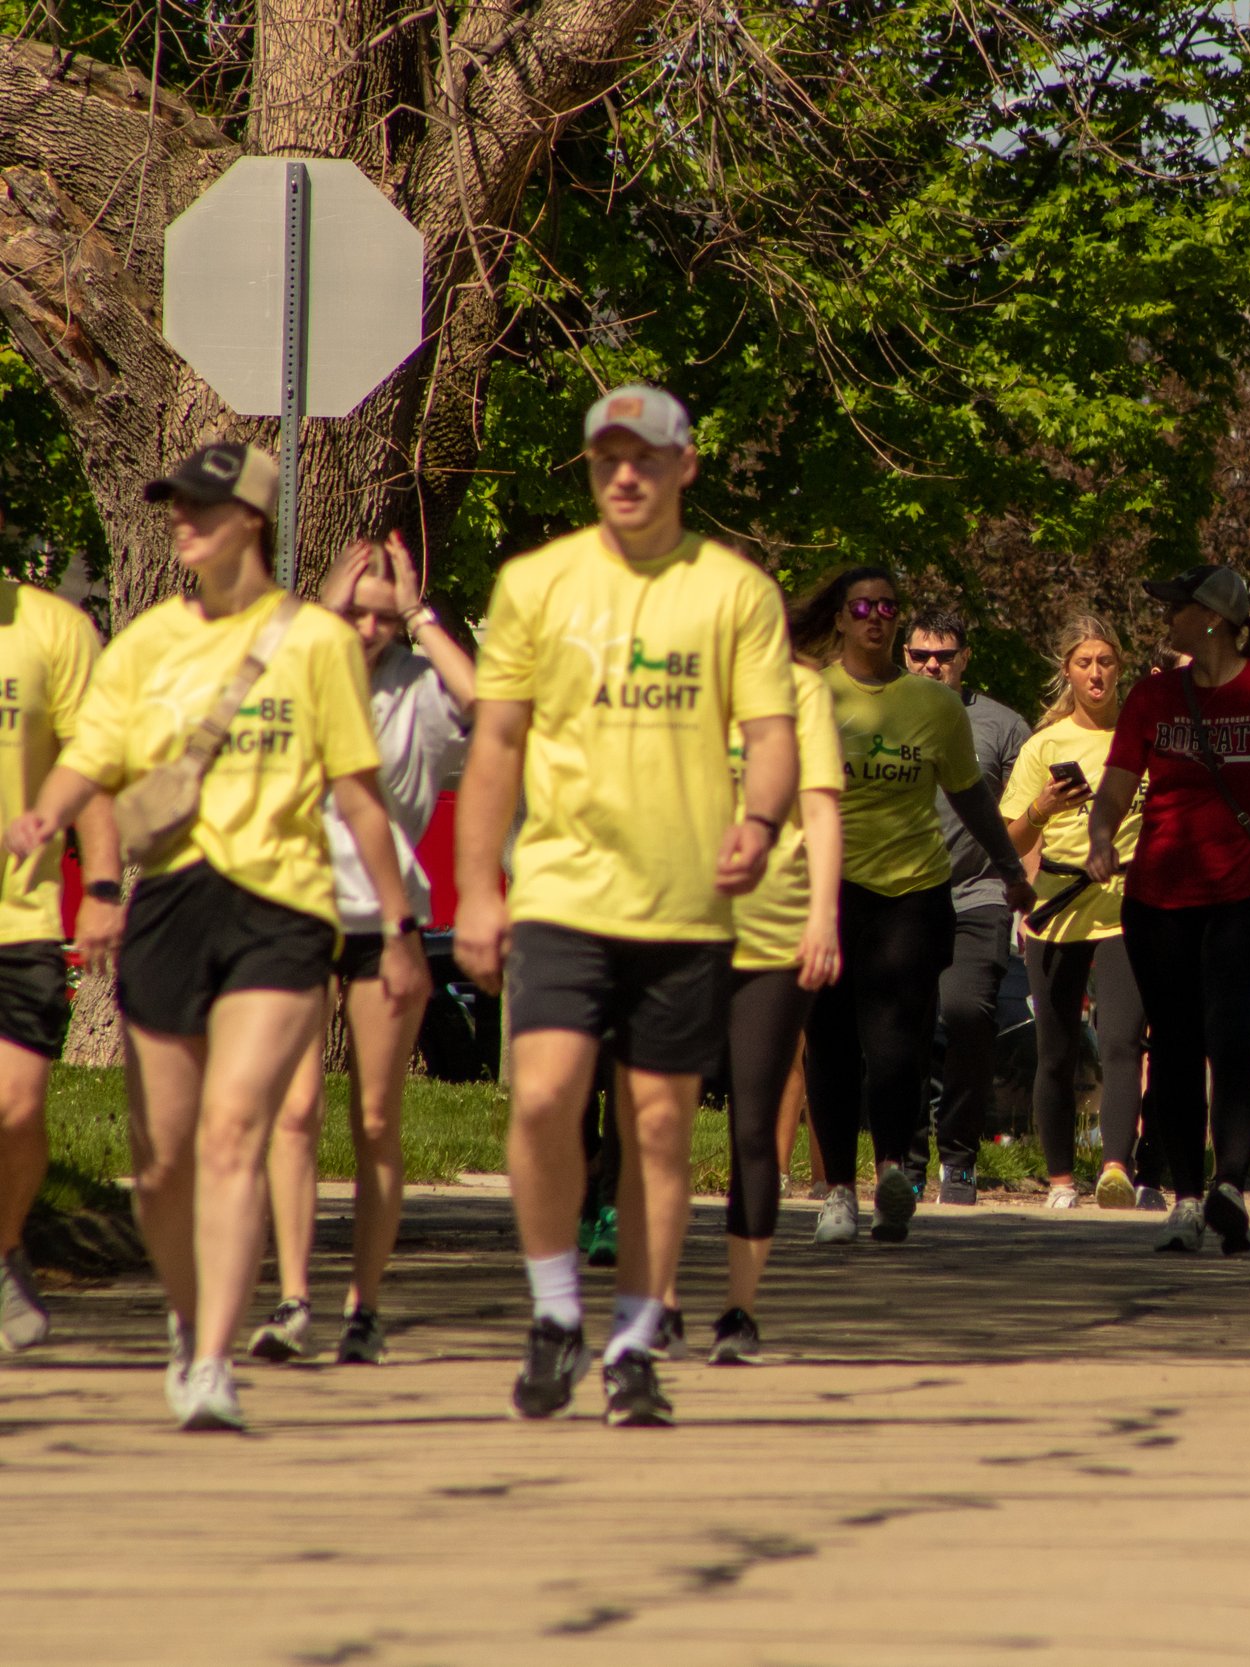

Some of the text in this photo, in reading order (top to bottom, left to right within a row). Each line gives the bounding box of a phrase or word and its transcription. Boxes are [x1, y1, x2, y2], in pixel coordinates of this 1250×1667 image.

[666, 652, 700, 677] BE
[0, 678, 17, 700] E
[592, 684, 702, 710] A LIGHT
[261, 698, 293, 722] BE
[901, 744, 921, 762] BE
[844, 761, 921, 783] A LIGHT
